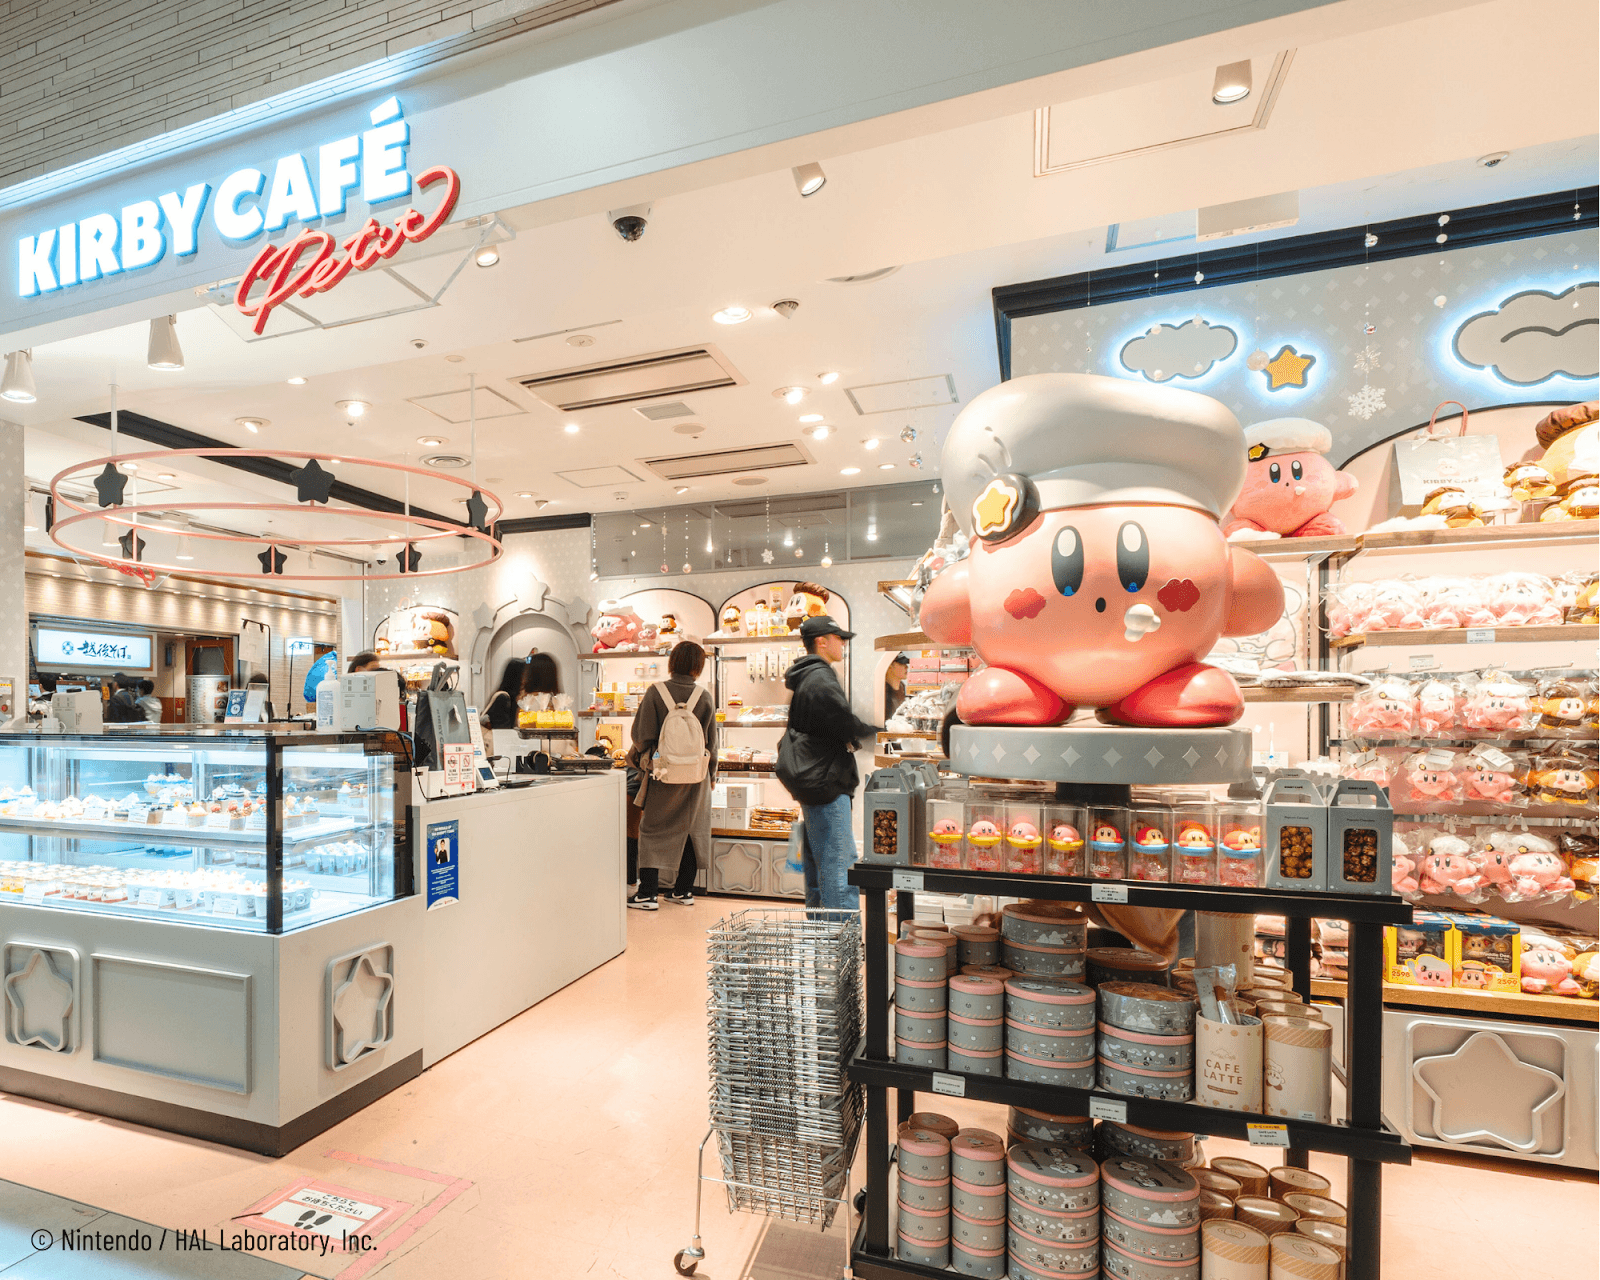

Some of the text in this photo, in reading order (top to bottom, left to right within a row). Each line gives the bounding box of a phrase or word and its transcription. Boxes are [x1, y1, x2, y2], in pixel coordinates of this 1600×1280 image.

[18, 96, 411, 298] KIRBY CAFÉ
[234, 165, 461, 335] Petit
[1206, 1059, 1240, 1074] CAFE
[1203, 1069, 1242, 1085] LATTE
[301, 1196, 363, 1216] お待ちください
[322, 1194, 358, 1207] こちらで
